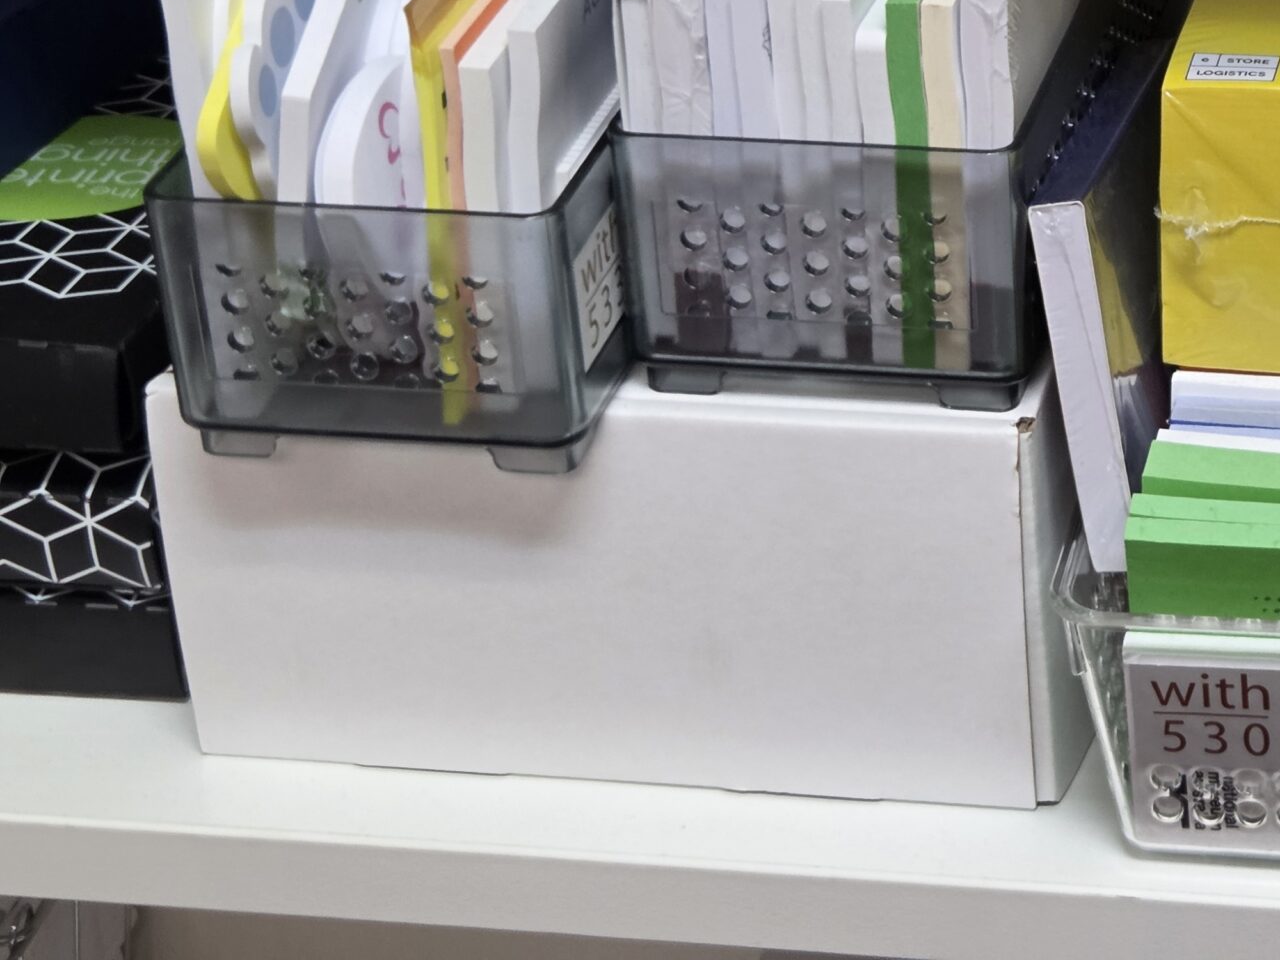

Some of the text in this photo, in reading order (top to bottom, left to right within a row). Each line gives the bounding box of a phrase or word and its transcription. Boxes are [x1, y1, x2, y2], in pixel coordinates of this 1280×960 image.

[1196, 69, 1267, 78] LOGISTICS
[1227, 57, 1270, 66] STORE
[90, 185, 141, 200] the
[580, 211, 617, 293] with
[1150, 673, 1271, 711] with
[1163, 720, 1271, 757] 530
